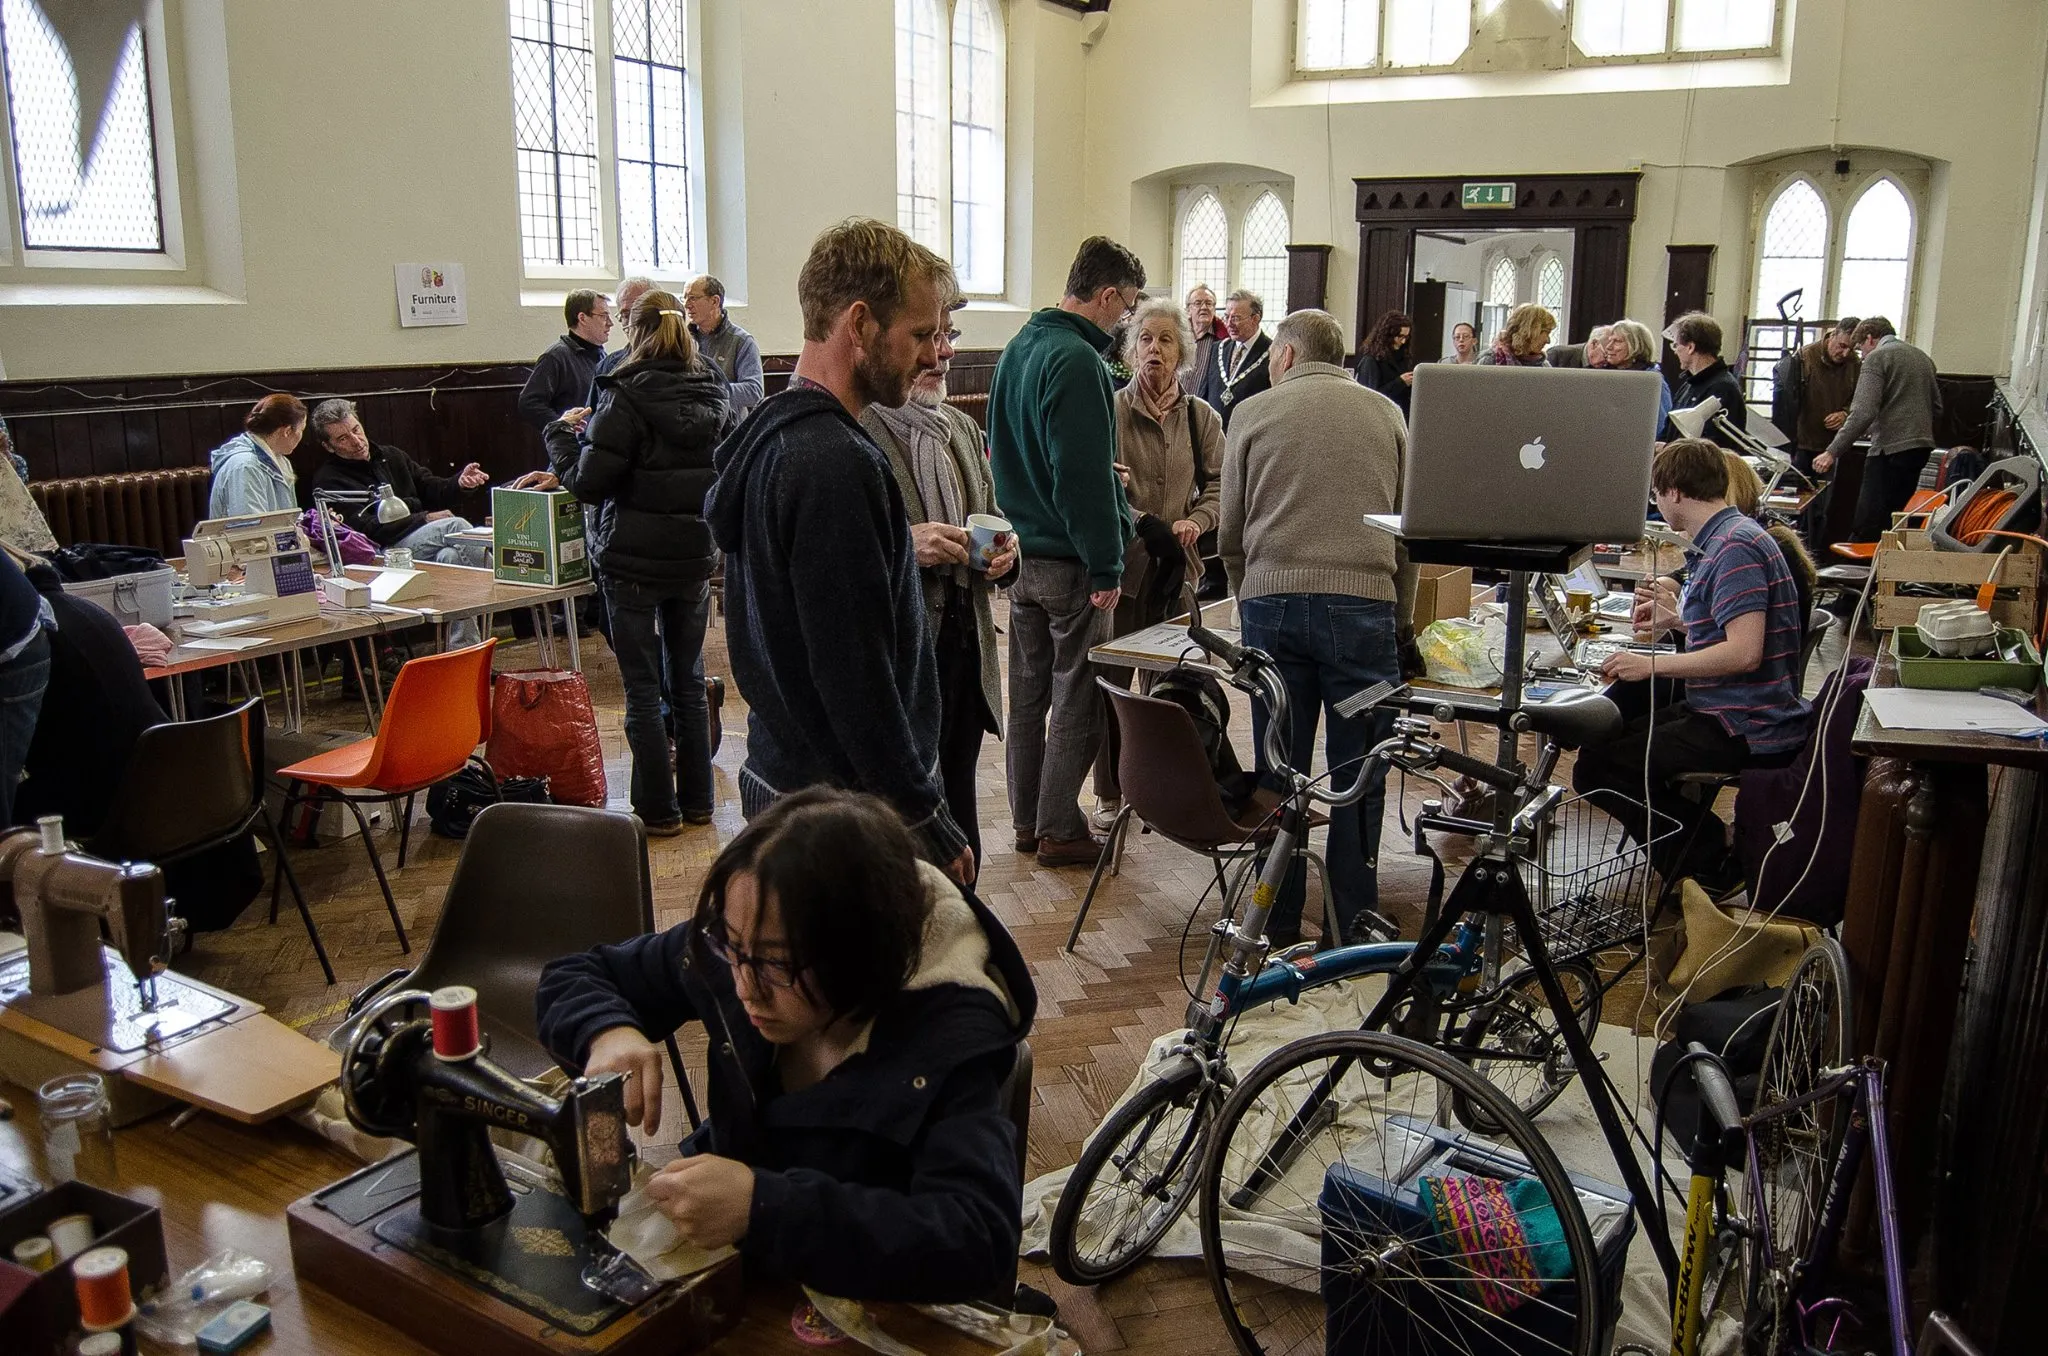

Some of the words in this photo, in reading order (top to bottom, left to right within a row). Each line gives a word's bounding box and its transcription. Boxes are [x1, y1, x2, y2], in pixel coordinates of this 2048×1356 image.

[412, 293, 457, 305] Furniture
[516, 533, 530, 541] VINI
[507, 538, 539, 548] SPUMANTI
[463, 1095, 530, 1130] SINGER
